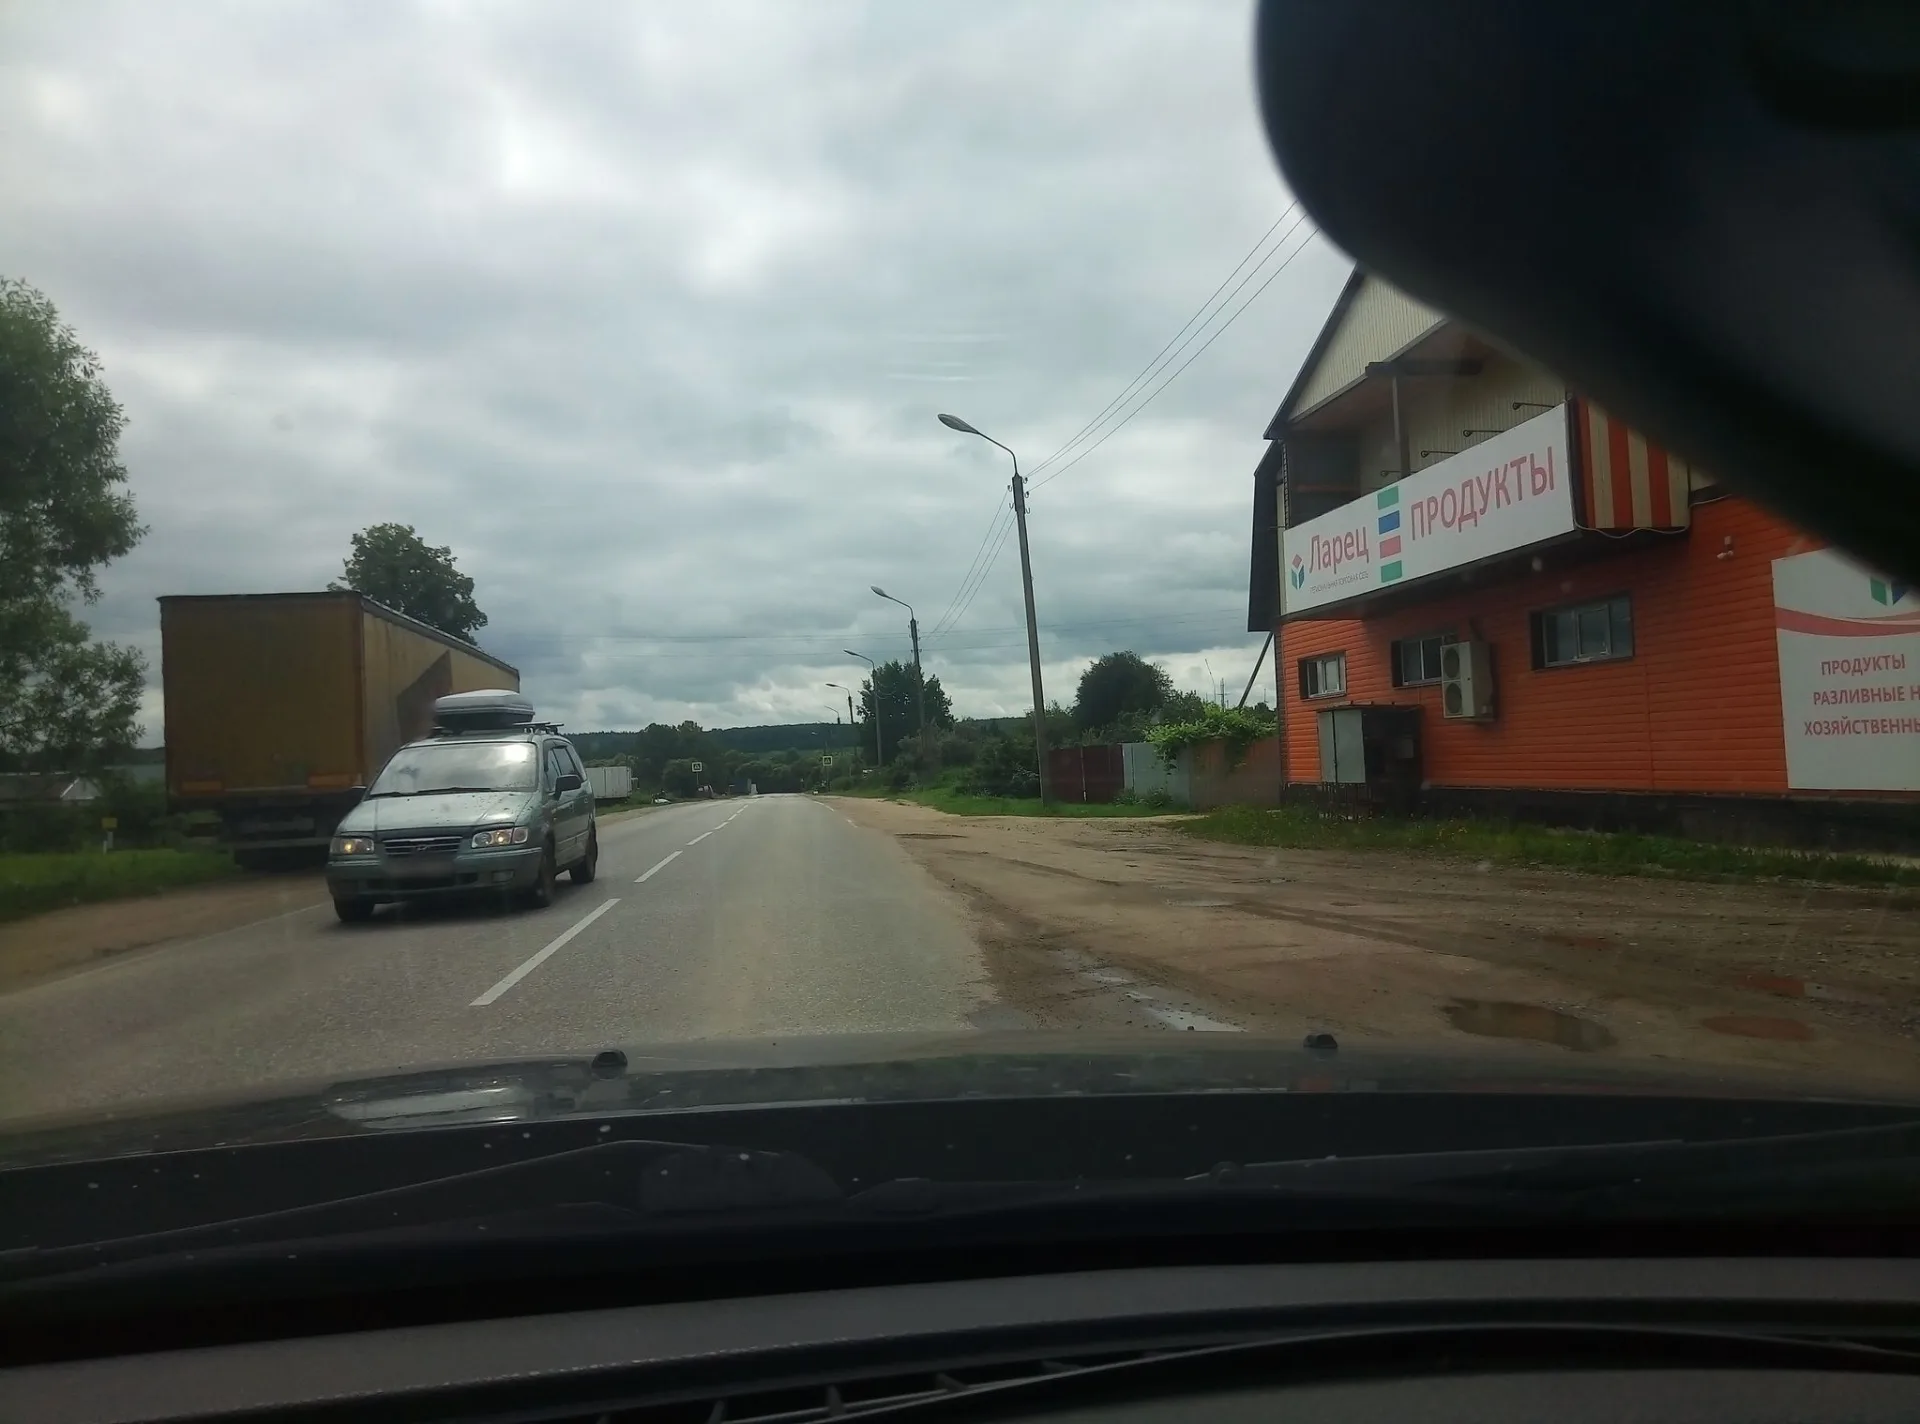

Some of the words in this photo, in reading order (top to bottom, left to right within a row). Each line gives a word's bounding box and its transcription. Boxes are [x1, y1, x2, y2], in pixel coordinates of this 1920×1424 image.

[1410, 446, 1556, 541] ПРОДУКТЫ
[1308, 526, 1370, 575] Ларец
[1821, 653, 1906, 676] ПРОДУКТЫ
[1813, 685, 1905, 706] РАЗЛИВНЫЕ
